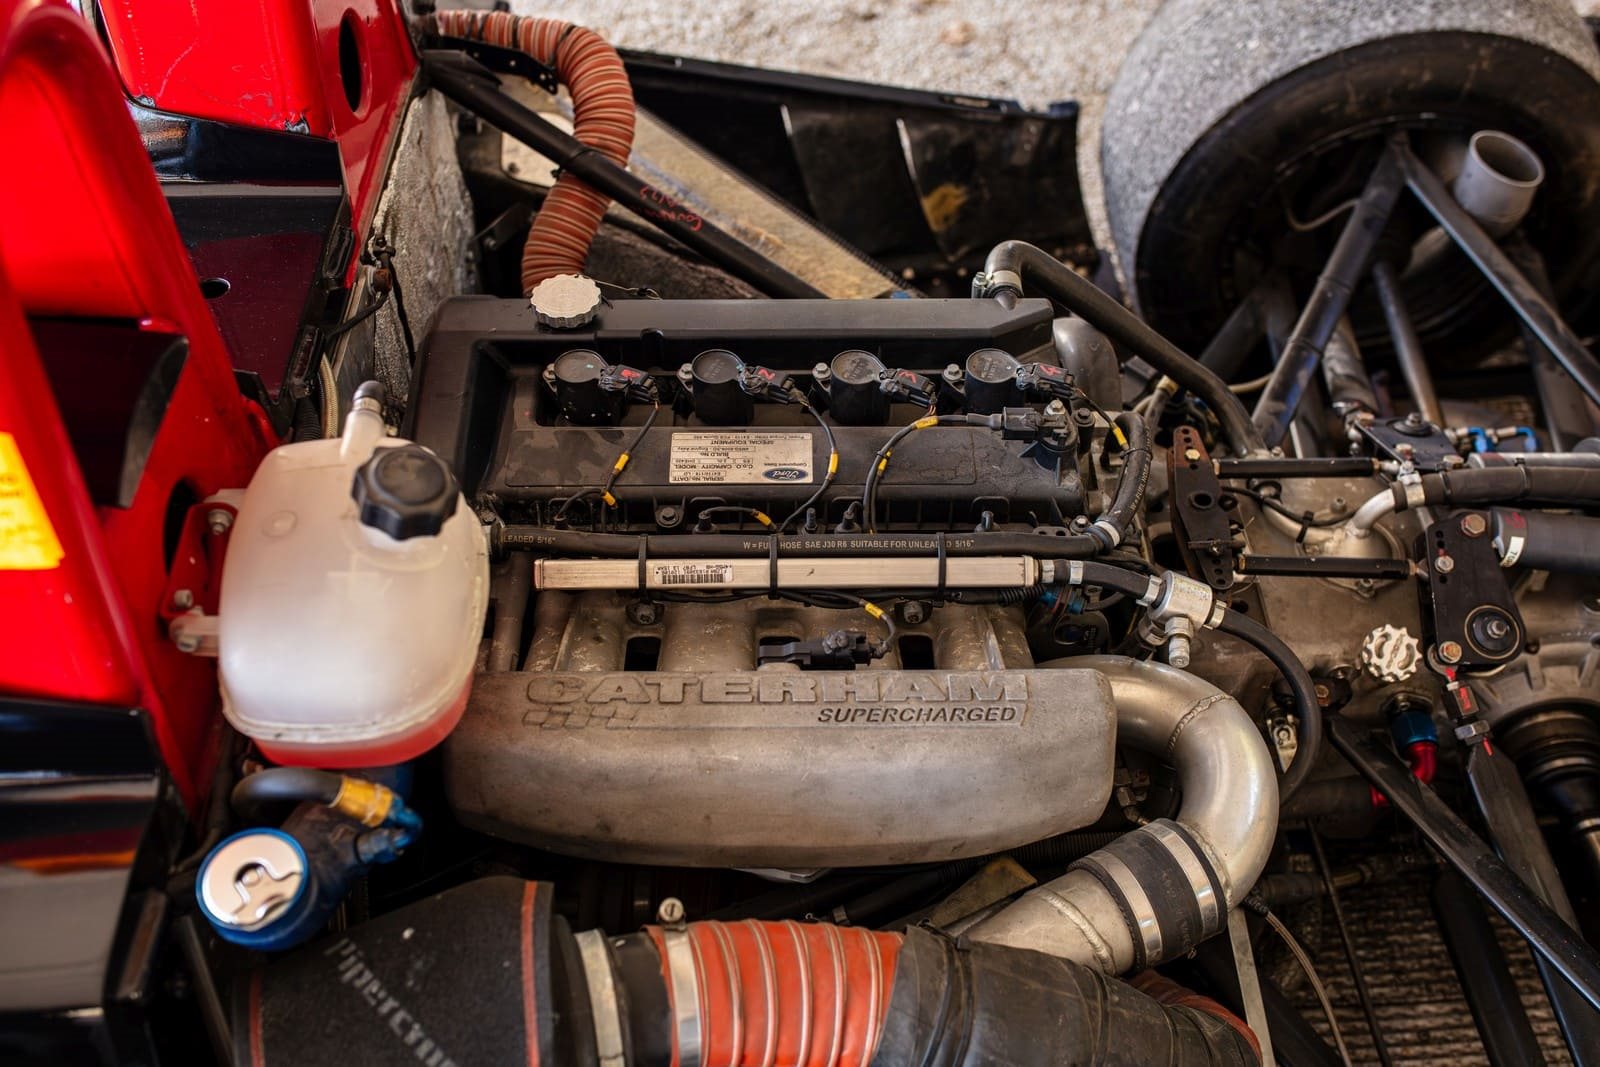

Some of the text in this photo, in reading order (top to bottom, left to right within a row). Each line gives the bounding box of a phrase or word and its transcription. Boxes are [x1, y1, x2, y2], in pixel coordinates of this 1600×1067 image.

[780, 541, 802, 550] HOSE
[804, 541, 820, 549] SAE
[850, 540, 889, 548] SUITABLE
[890, 540, 906, 548] FOR
[908, 540, 952, 548] UNLEAD
[525, 674, 1029, 704] CATERHAM
[817, 706, 1017, 723] SUPERCHARGED
